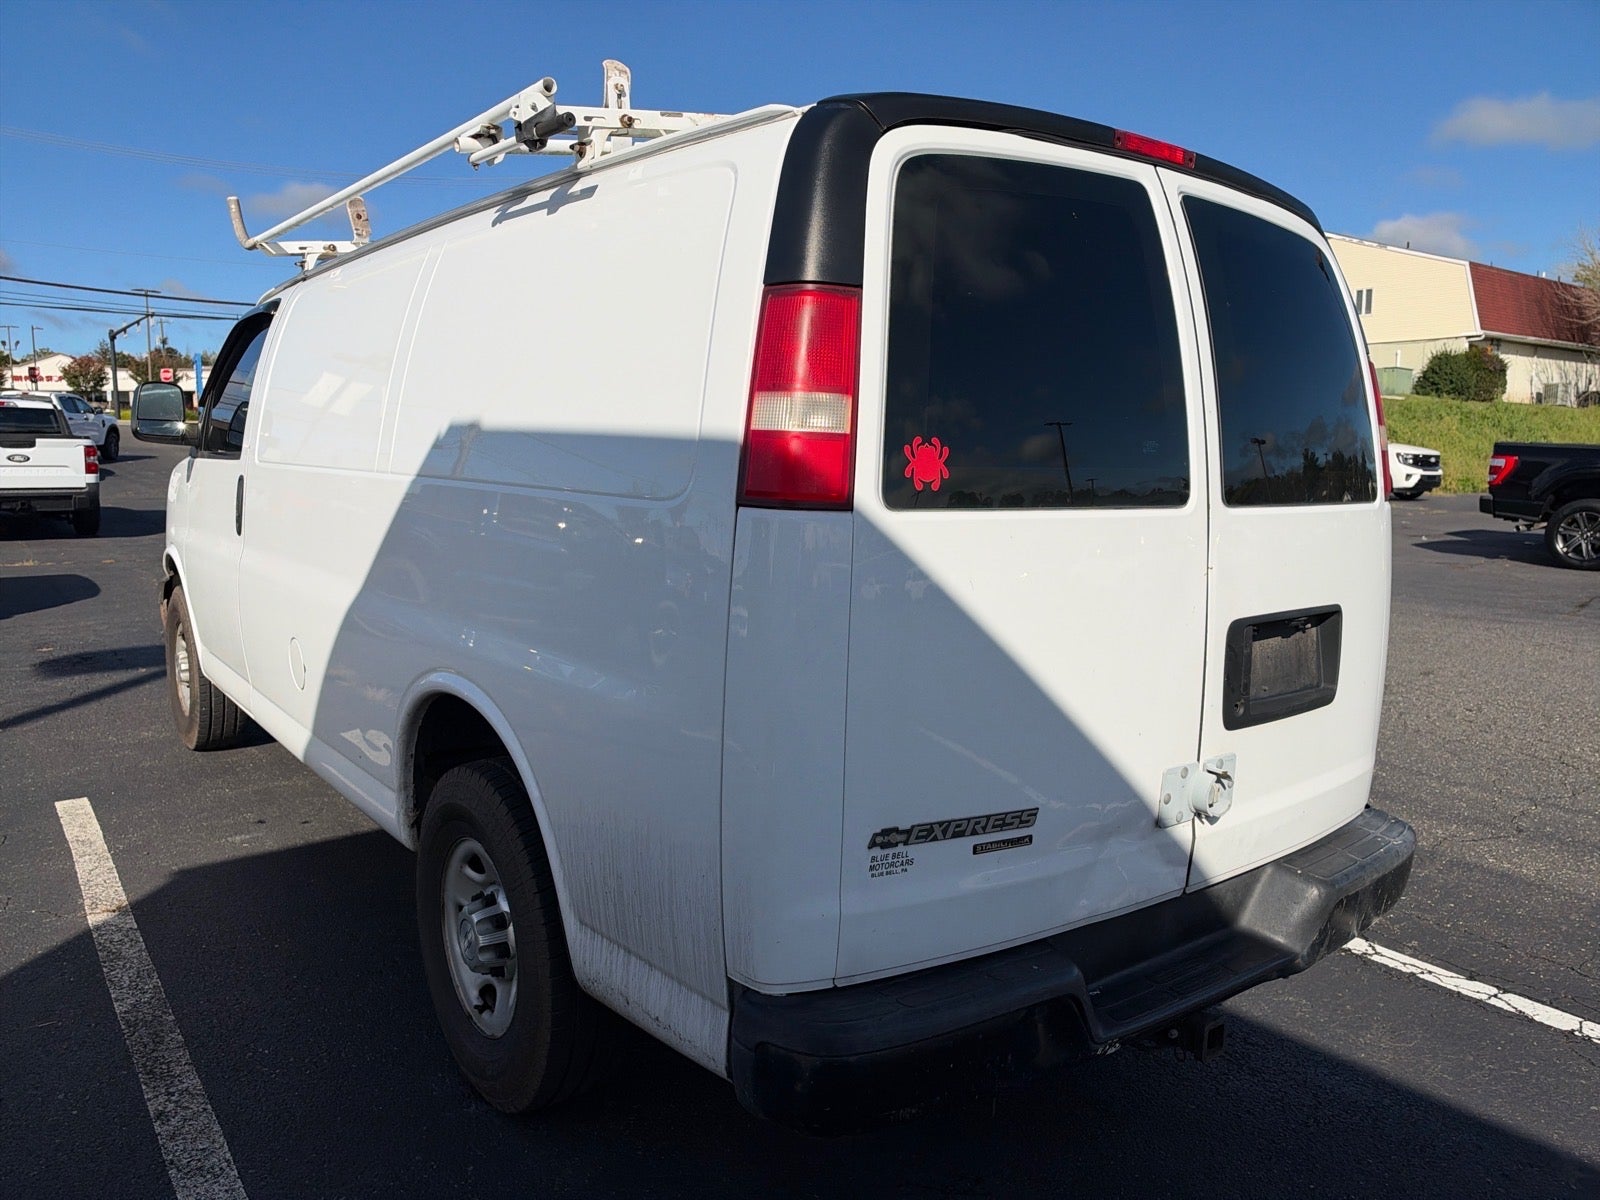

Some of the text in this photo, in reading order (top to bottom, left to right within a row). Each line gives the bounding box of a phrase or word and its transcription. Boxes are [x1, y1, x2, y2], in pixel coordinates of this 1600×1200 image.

[907, 809, 1038, 844] EXPRESS
[870, 851, 909, 863] BLUE BELL
[868, 858, 915, 873] MOTORCARS
